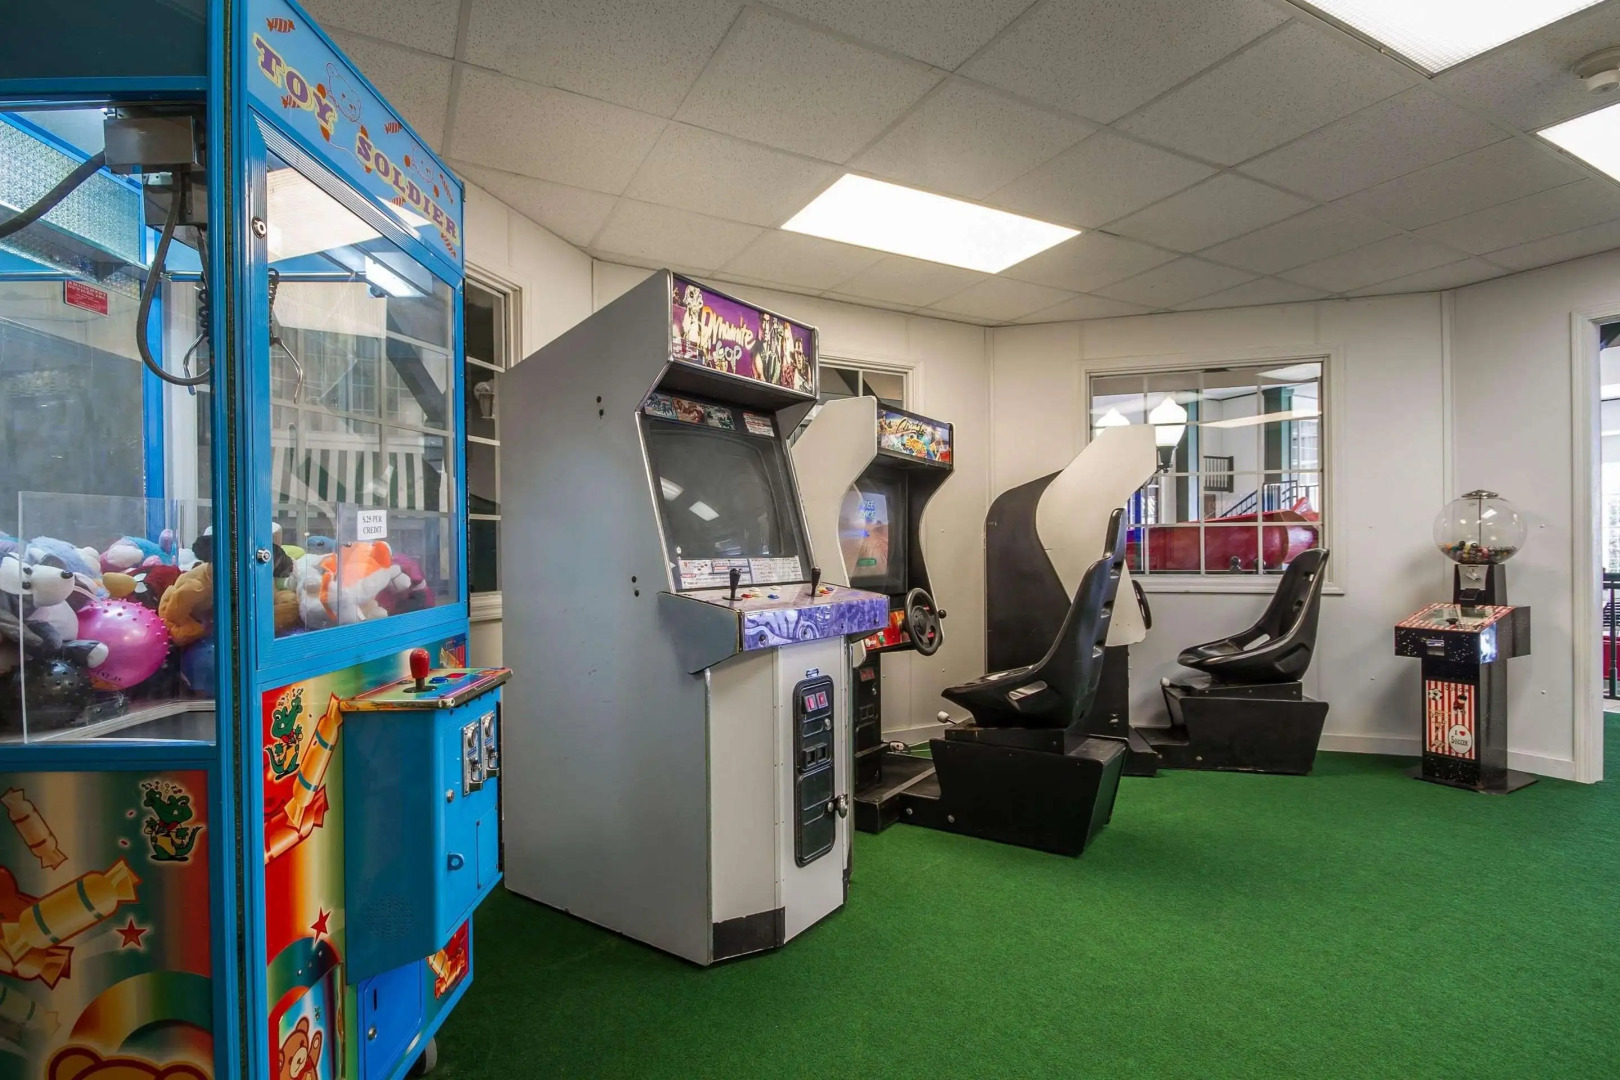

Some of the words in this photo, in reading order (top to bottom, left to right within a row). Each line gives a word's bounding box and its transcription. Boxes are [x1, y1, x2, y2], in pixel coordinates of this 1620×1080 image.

[252, 32, 338, 135] TOY
[355, 132, 460, 246] SOLDIER
[372, 515, 383, 523] PER
[362, 526, 383, 534] CREDIT
